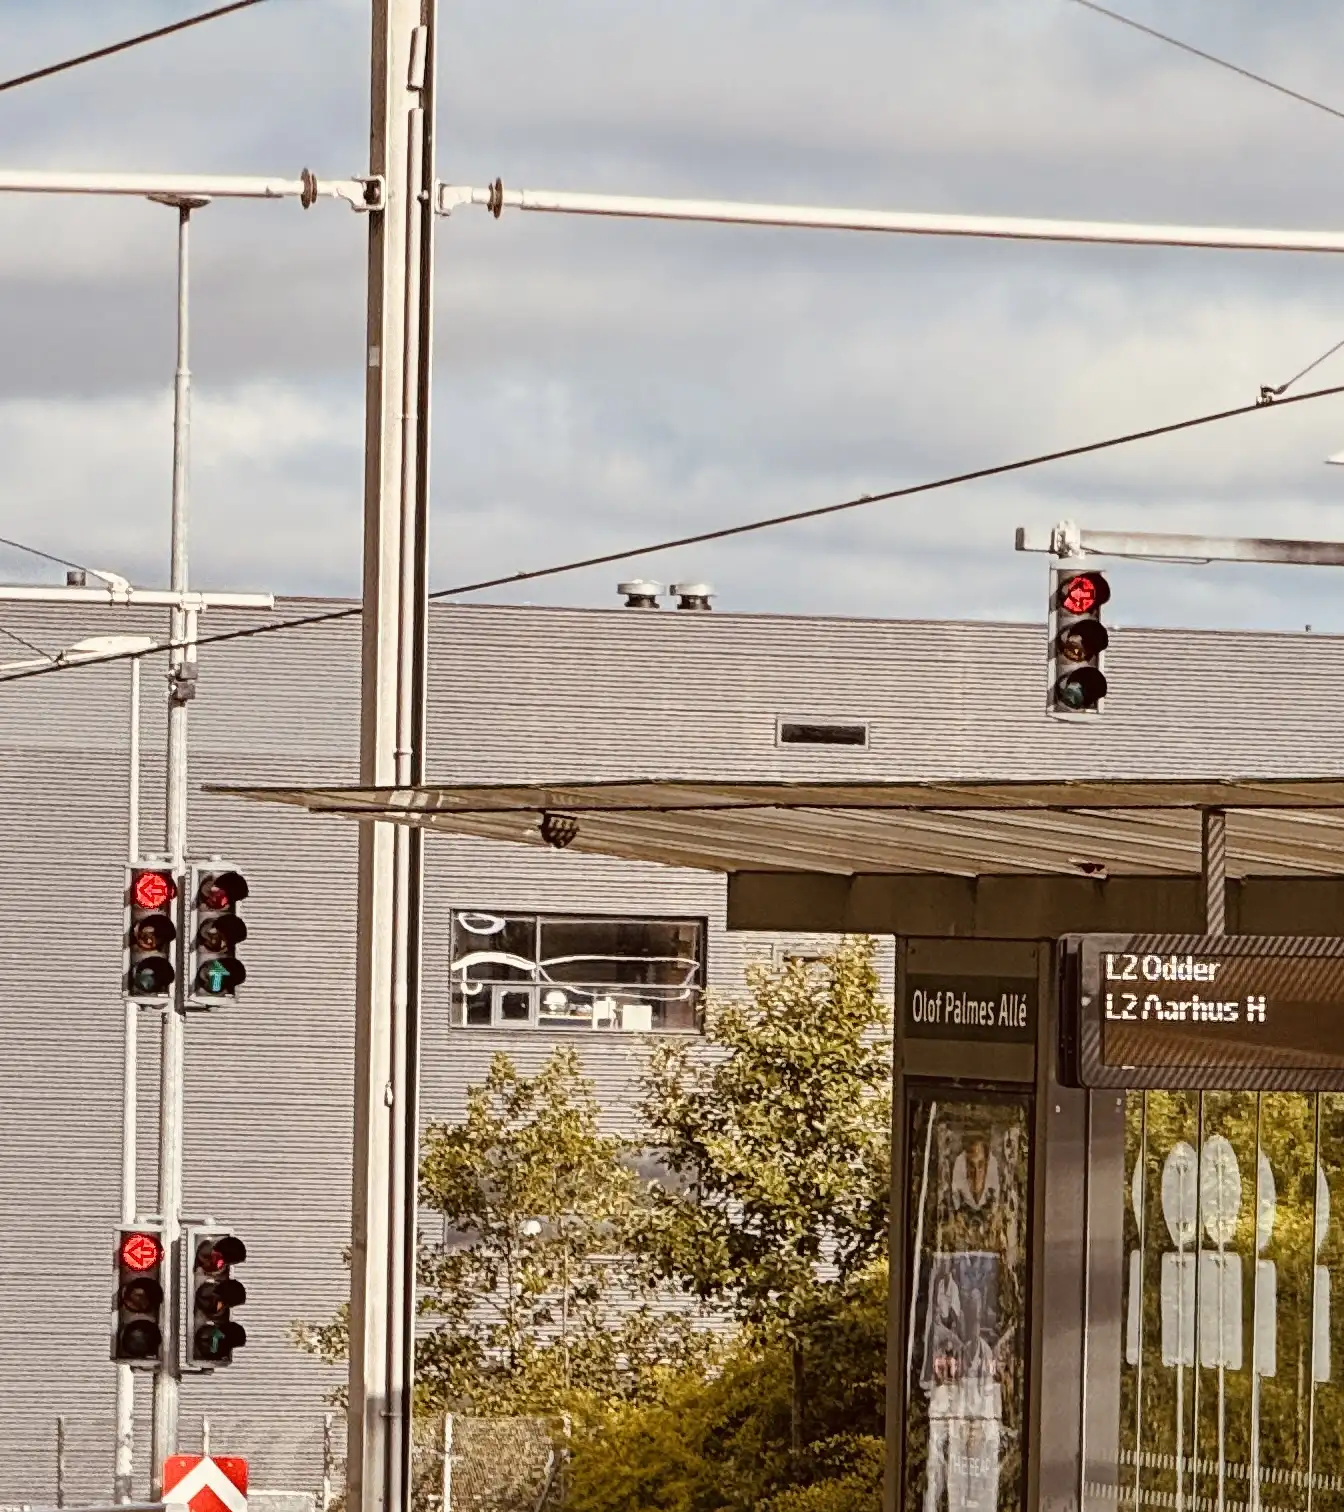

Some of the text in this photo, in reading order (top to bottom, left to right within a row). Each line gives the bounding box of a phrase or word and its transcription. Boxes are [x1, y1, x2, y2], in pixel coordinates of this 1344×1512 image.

[1106, 955, 1138, 982] L2
[1141, 956, 1220, 982] Odder
[912, 989, 1027, 1027] Olof Palmes Allé
[1105, 993, 1137, 1021] L2
[1246, 995, 1266, 1022] H
